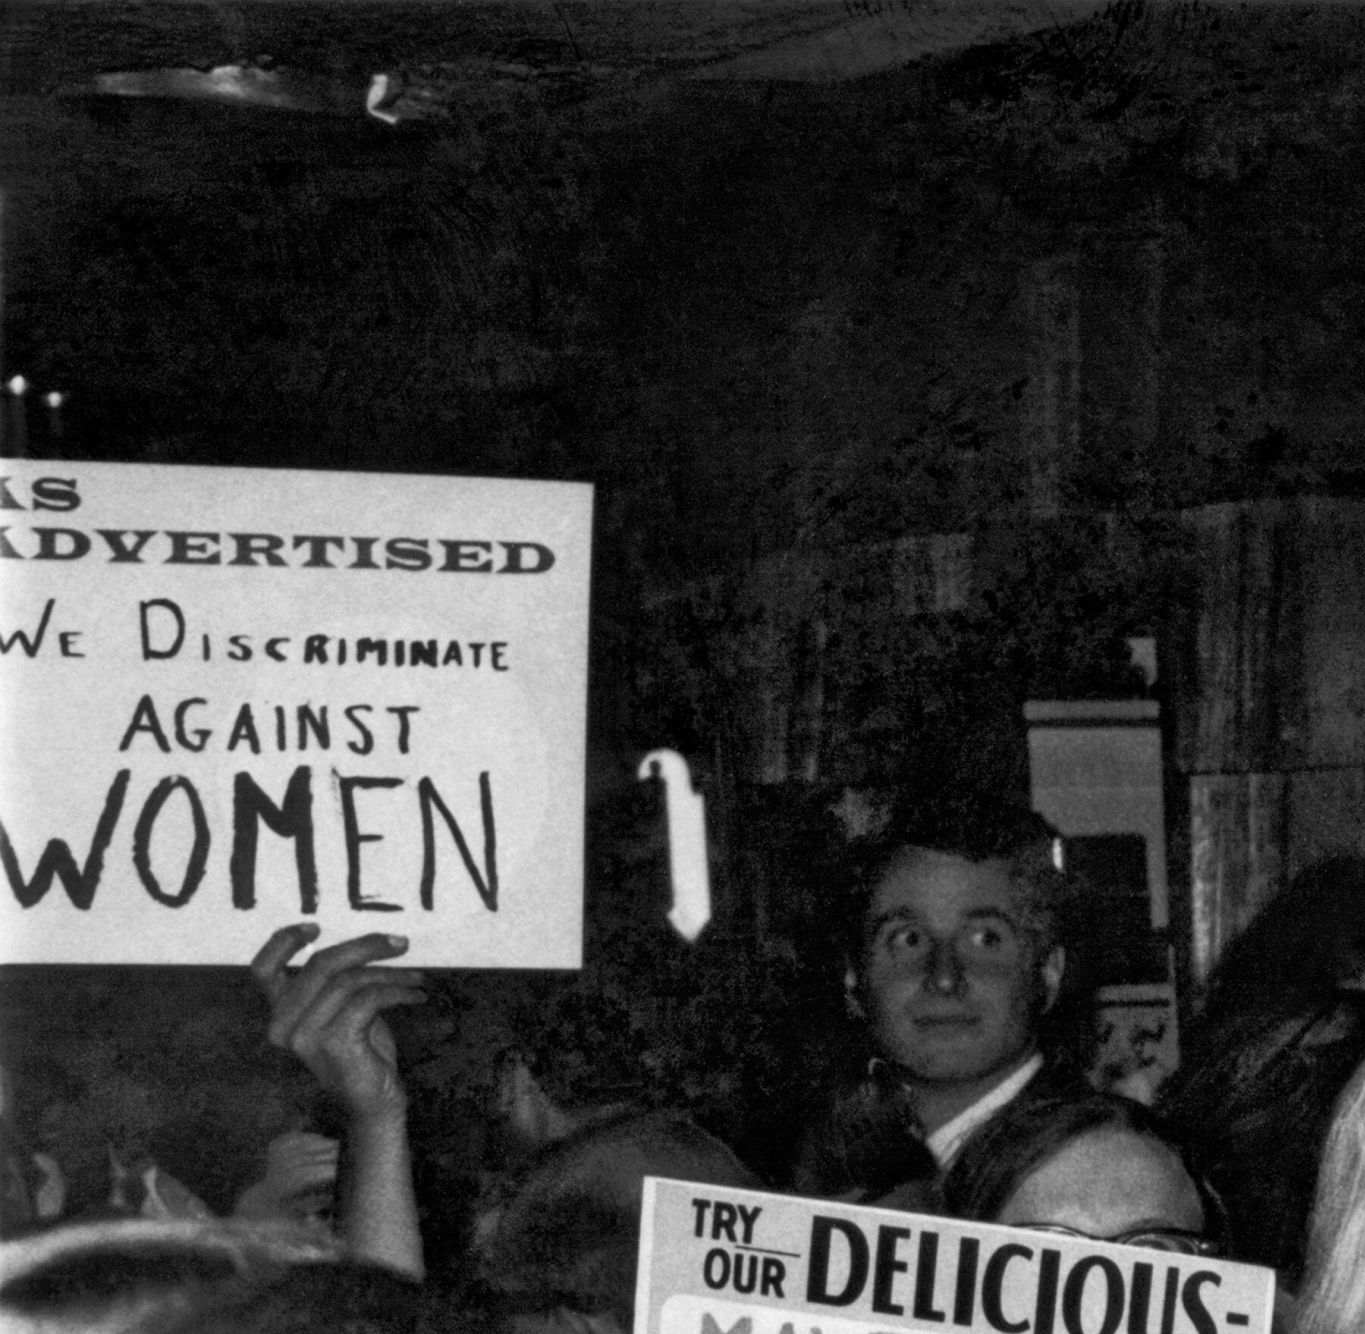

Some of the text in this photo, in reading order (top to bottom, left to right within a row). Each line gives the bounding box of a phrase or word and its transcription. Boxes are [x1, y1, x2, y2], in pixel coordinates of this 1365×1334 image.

[118, 694, 421, 755] AGAINST
[0, 765, 499, 914] WOMEN
[691, 1198, 763, 1245] TRY
[703, 1248, 786, 1299] OUR
